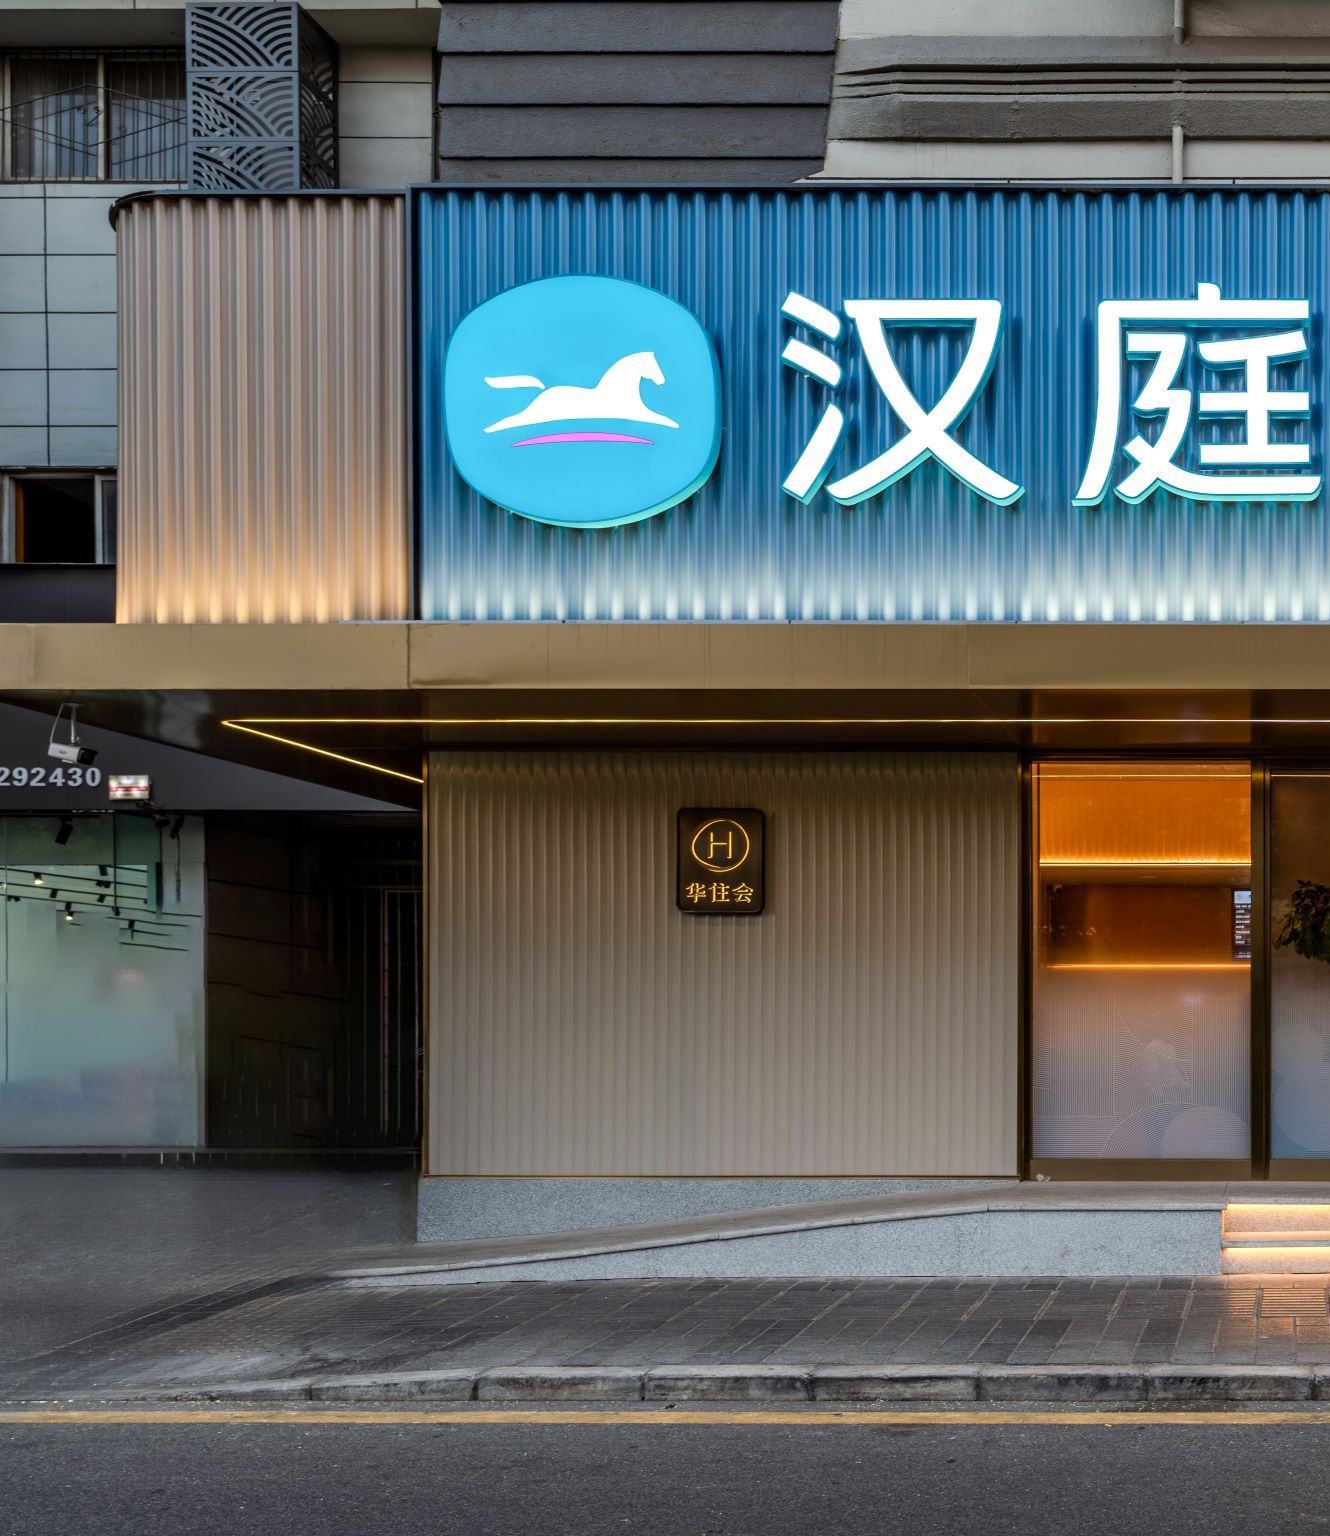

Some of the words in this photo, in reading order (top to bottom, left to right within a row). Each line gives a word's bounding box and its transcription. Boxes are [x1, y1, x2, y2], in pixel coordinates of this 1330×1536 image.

[0, 767, 102, 787] 292430
[685, 882, 754, 904] 华住会
